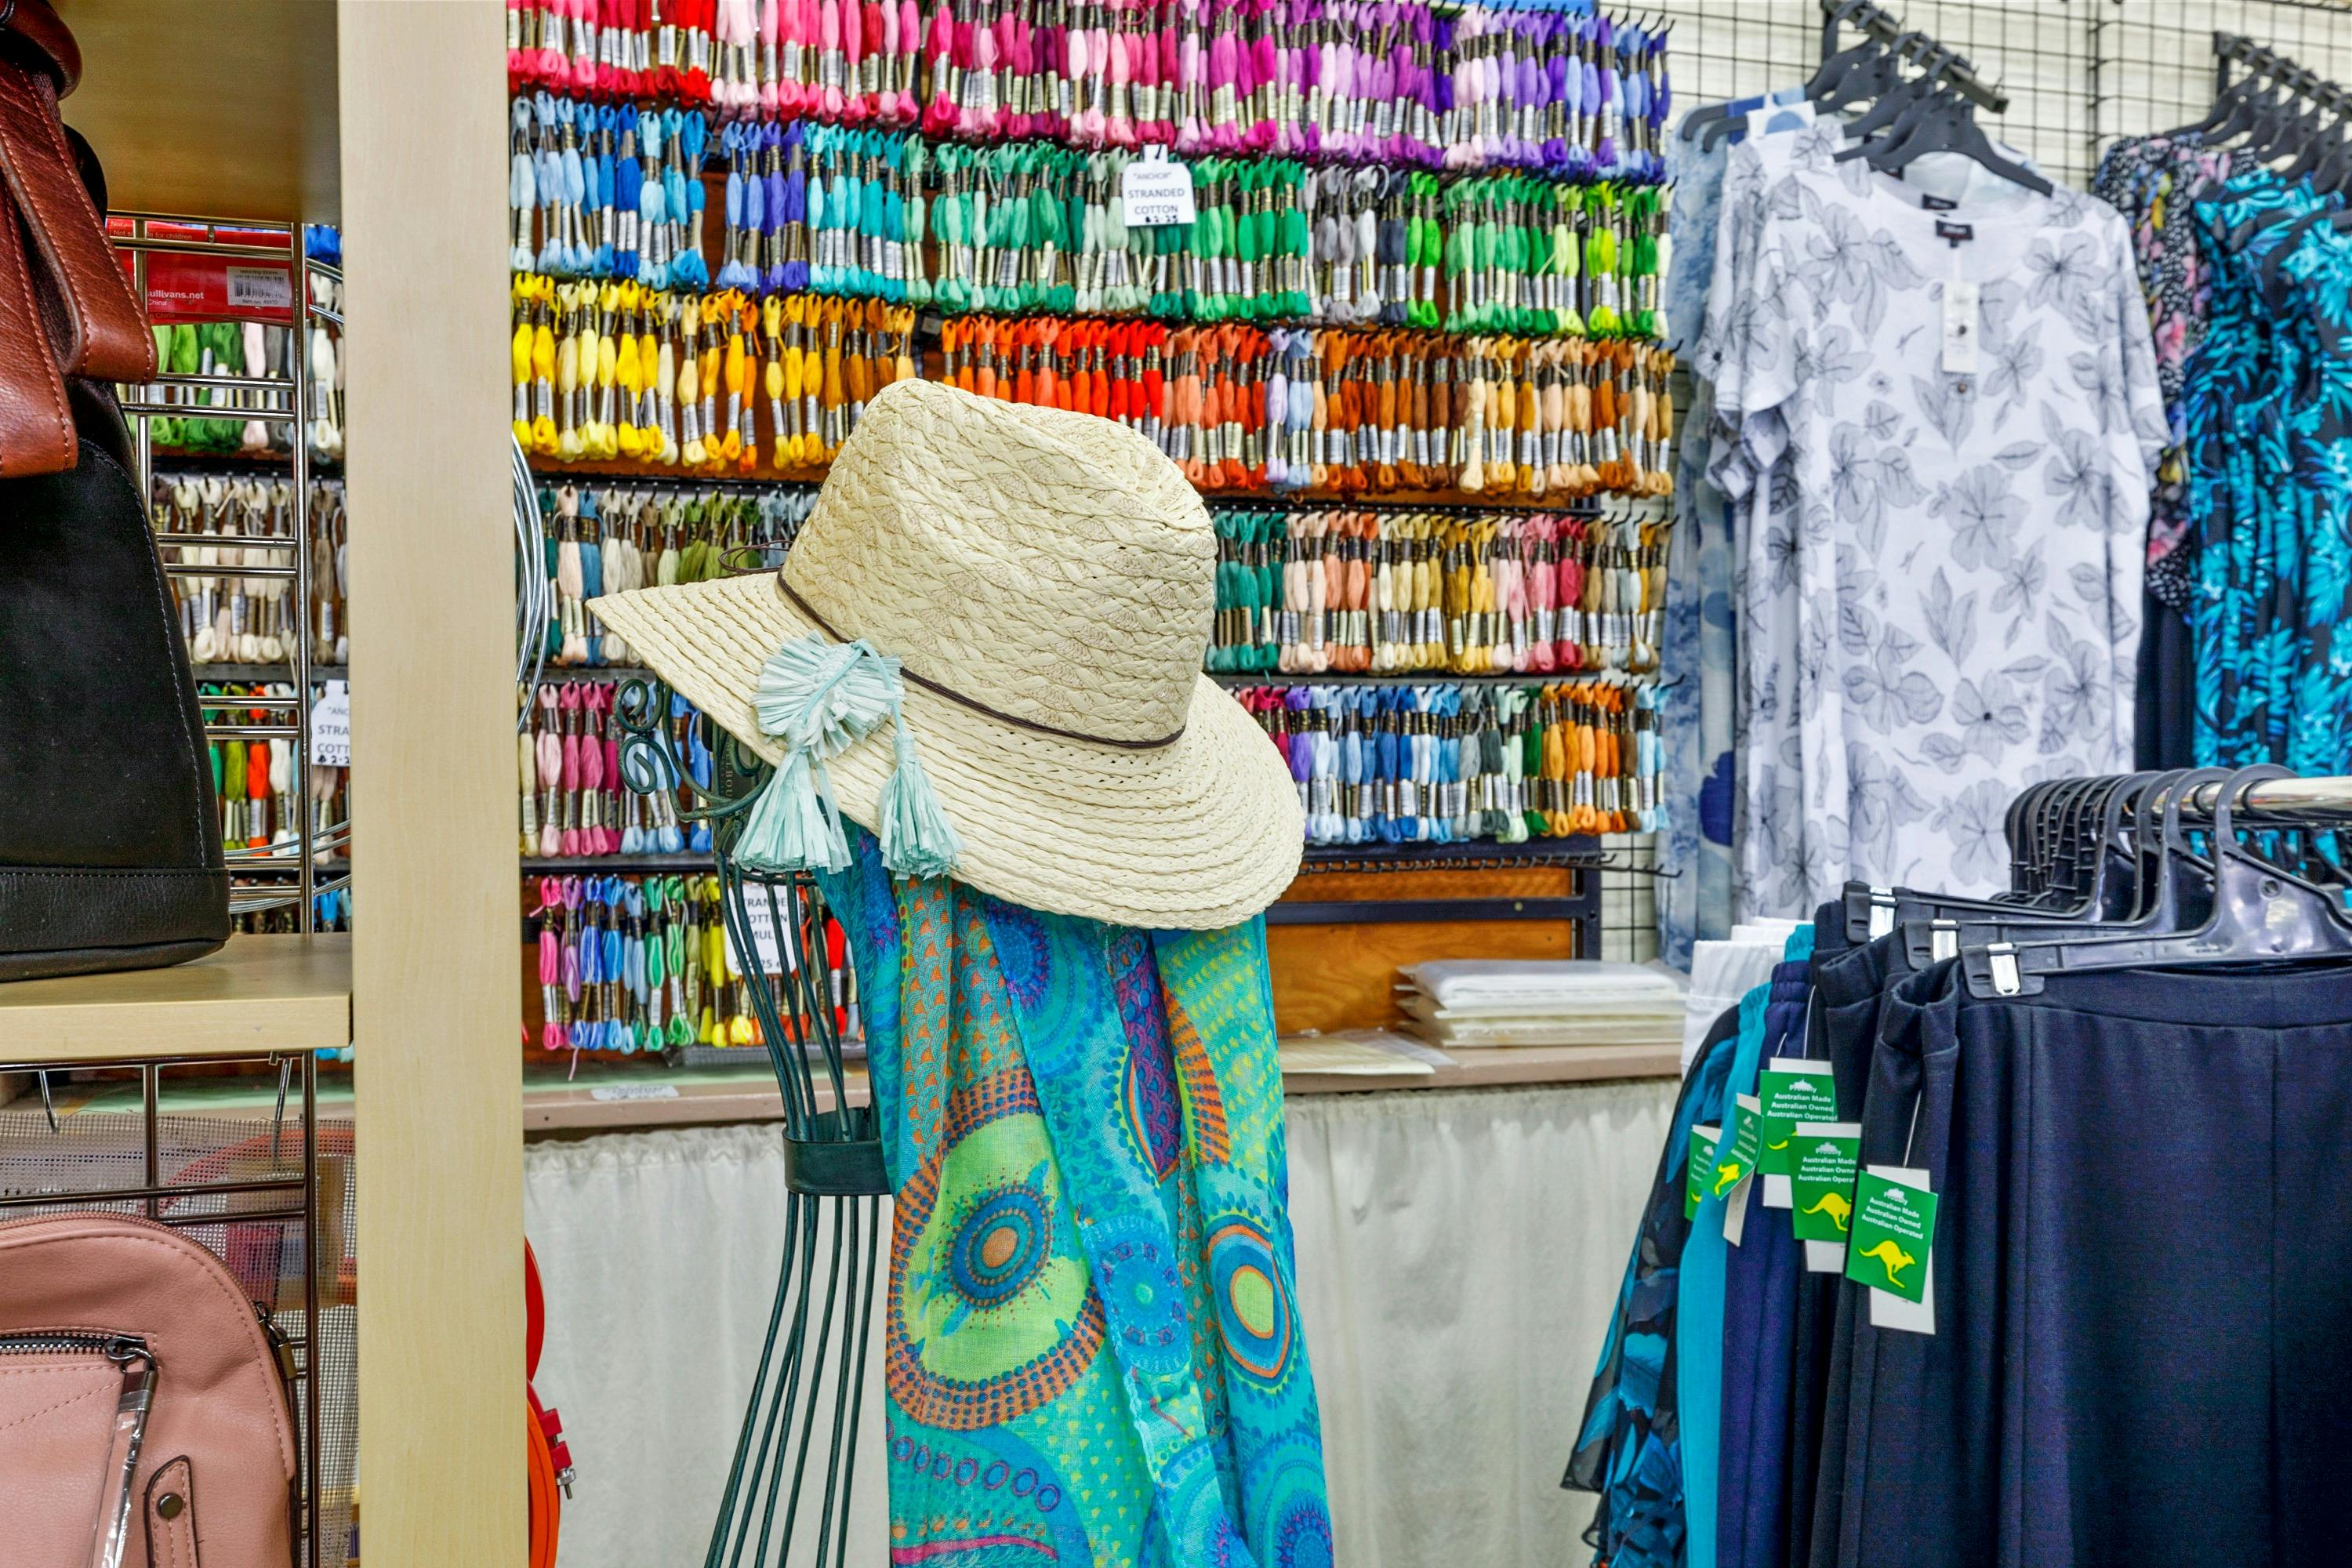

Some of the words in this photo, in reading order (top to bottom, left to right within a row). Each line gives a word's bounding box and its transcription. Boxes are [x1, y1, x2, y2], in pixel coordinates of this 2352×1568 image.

[1128, 188, 1185, 198] STRANDED
[1134, 205, 1178, 215] COTTON
[318, 724, 350, 735] STRA
[318, 742, 350, 753] COTT
[748, 913, 788, 923] OTTN
[1808, 1104, 1834, 1112] Owned
[1767, 1110, 1803, 1119] Australian
[1869, 1196, 1901, 1212] Australian
[1901, 1207, 1920, 1218] Made
[1866, 1205, 1898, 1221] Australian
[1898, 1216, 1922, 1229] Owned
[1861, 1214, 1893, 1229] Australian
[1893, 1224, 1924, 1240] Operated
